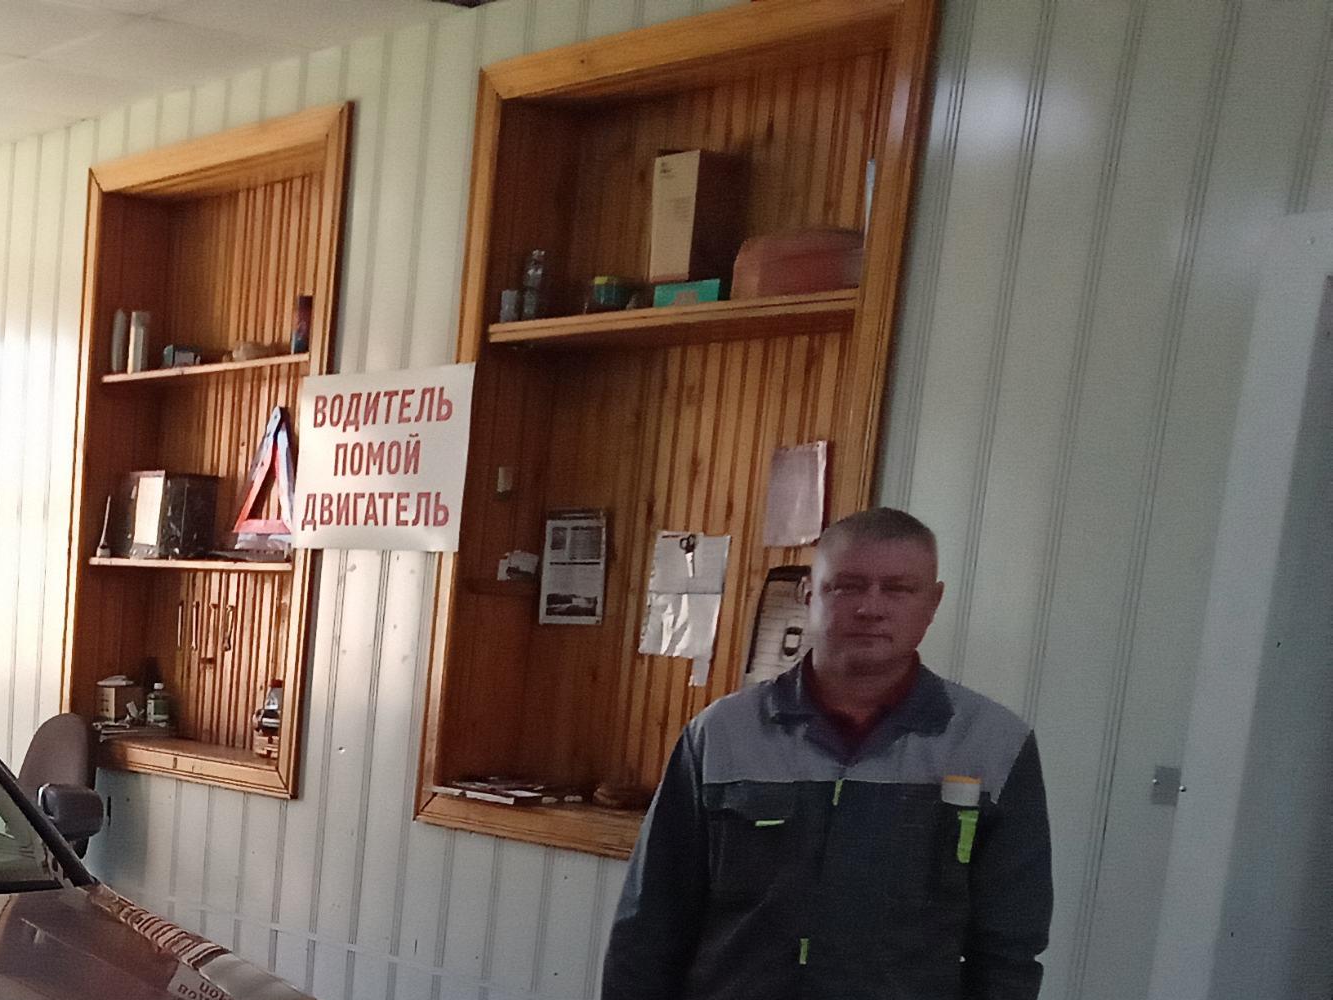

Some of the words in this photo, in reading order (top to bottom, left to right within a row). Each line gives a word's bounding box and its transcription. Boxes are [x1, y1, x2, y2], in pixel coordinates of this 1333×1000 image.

[313, 386, 453, 432] ВОДИТЕЛЬ
[333, 433, 421, 477] ПОМОЙ
[301, 491, 450, 531] ДВИГАТЕЛЬ
